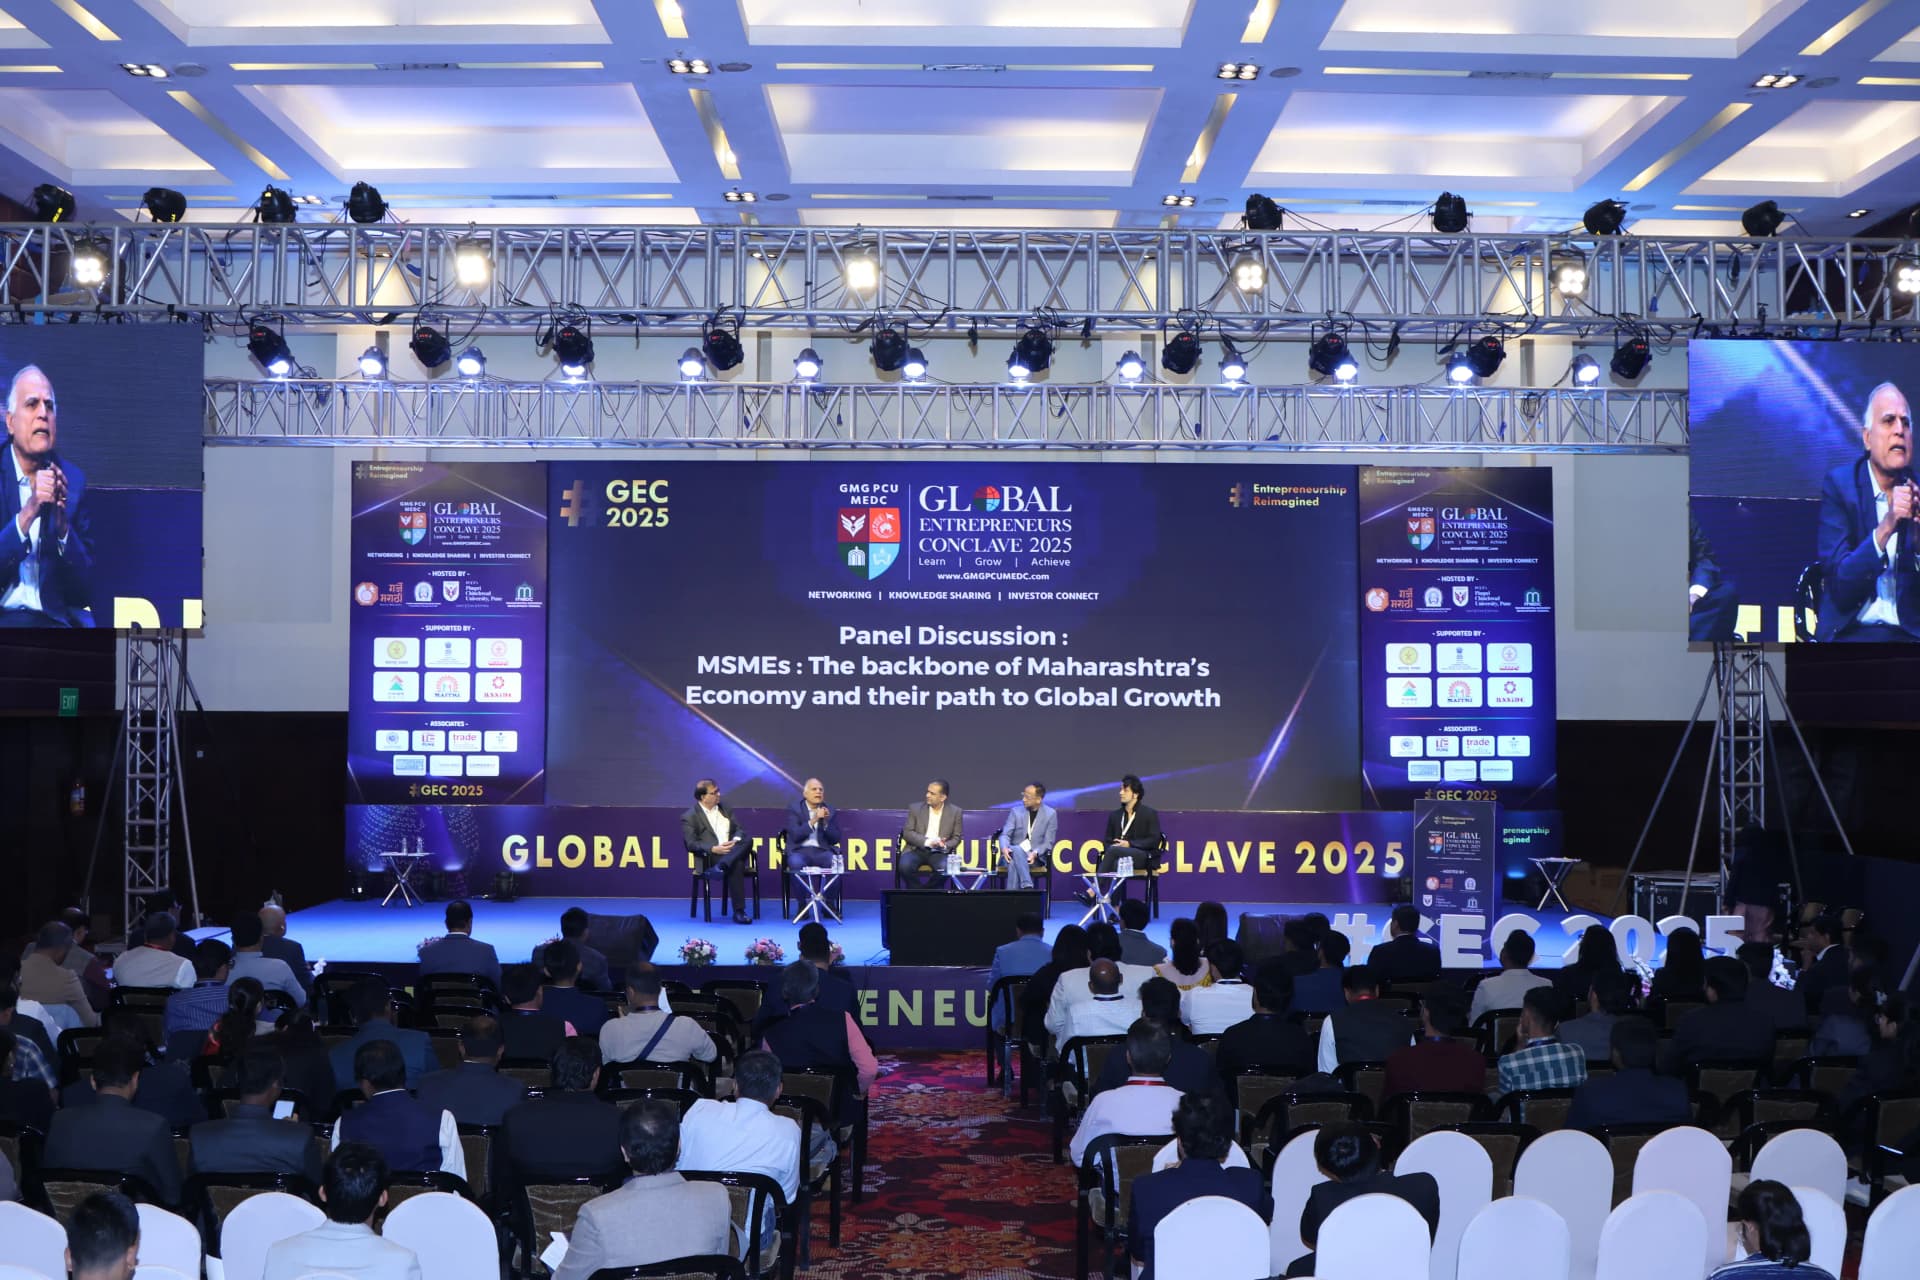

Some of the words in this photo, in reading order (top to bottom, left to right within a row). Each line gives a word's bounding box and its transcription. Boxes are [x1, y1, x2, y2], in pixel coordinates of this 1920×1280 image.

[606, 479, 668, 503] GEC
[839, 484, 870, 493] GMG
[873, 484, 899, 493] PCU
[1253, 484, 1347, 496] Entrepreneurship
[850, 496, 887, 505] MEDC
[919, 485, 1072, 513] GLOBAL
[1253, 496, 1320, 508] Reimagined
[434, 502, 501, 516] GLOBAL
[1442, 507, 1508, 520] GLOBAL
[606, 507, 670, 528] 2025
[434, 526, 480, 534] CONCLAVE
[482, 526, 501, 534] 2025
[919, 518, 1072, 533] ENTREPRENEURS
[1442, 530, 1486, 538] CONCLAVE
[1488, 530, 1508, 538] 2025
[918, 537, 1023, 553] CONCLAVE
[1030, 537, 1072, 553] 2025
[918, 556, 946, 566] Learn
[974, 557, 1002, 568] Grow
[1031, 556, 1071, 567] Achieve
[937, 572, 1050, 582] www.GMGPCUMEDC.com
[808, 590, 872, 600] NETWORKING
[888, 591, 948, 600] KNOWLEDGE
[950, 591, 992, 600] SHARING
[1008, 592, 1053, 600] INVESTOR
[1054, 592, 1100, 601] CONNECT
[839, 626, 911, 645] Panel
[918, 624, 1056, 646] Discussion
[697, 655, 791, 675] MSMEs
[808, 655, 856, 675] The
[862, 656, 990, 676] backbone
[995, 656, 1022, 676] of
[1027, 656, 1210, 677] Maharashtra's
[62, 696, 76, 710] EXIT
[685, 686, 807, 710] Economy
[812, 686, 860, 705] and
[867, 685, 930, 706] their
[936, 686, 996, 710] path
[1002, 688, 1029, 706] to
[1034, 686, 1118, 706] Global
[1124, 688, 1221, 708] Growth
[1466, 738, 1490, 746] trade
[452, 785, 484, 796] 2025
[1466, 790, 1497, 801] 2025
[1503, 826, 1550, 836] preneurship
[1503, 835, 1530, 844] agined
[501, 834, 669, 870] GLOBAL
[1294, 840, 1405, 875] 2025
